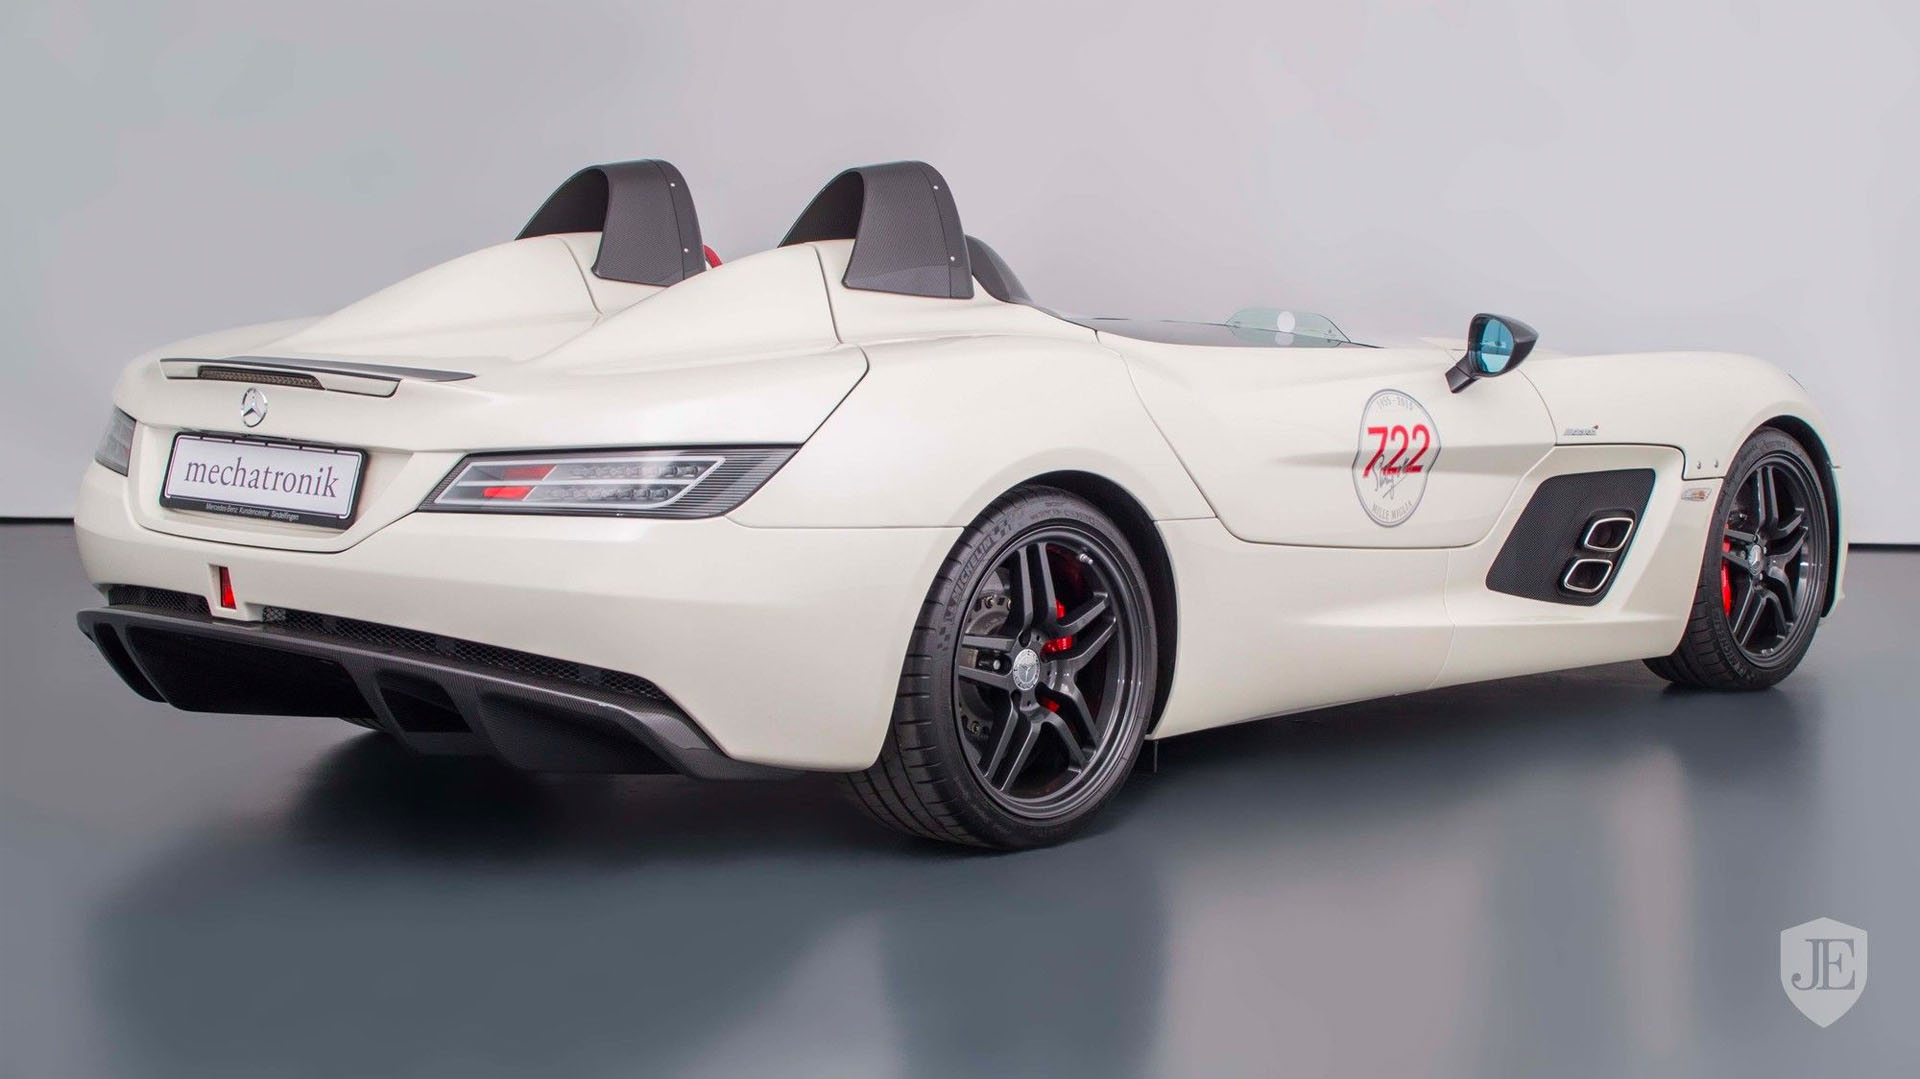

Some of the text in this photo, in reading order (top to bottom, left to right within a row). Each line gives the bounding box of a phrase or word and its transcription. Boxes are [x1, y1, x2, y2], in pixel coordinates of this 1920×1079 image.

[1362, 423, 1431, 478] 722
[184, 456, 340, 498] mechatronik
[205, 502, 239, 513] Mercedes-Benz
[950, 534, 994, 604] MICHELIN
